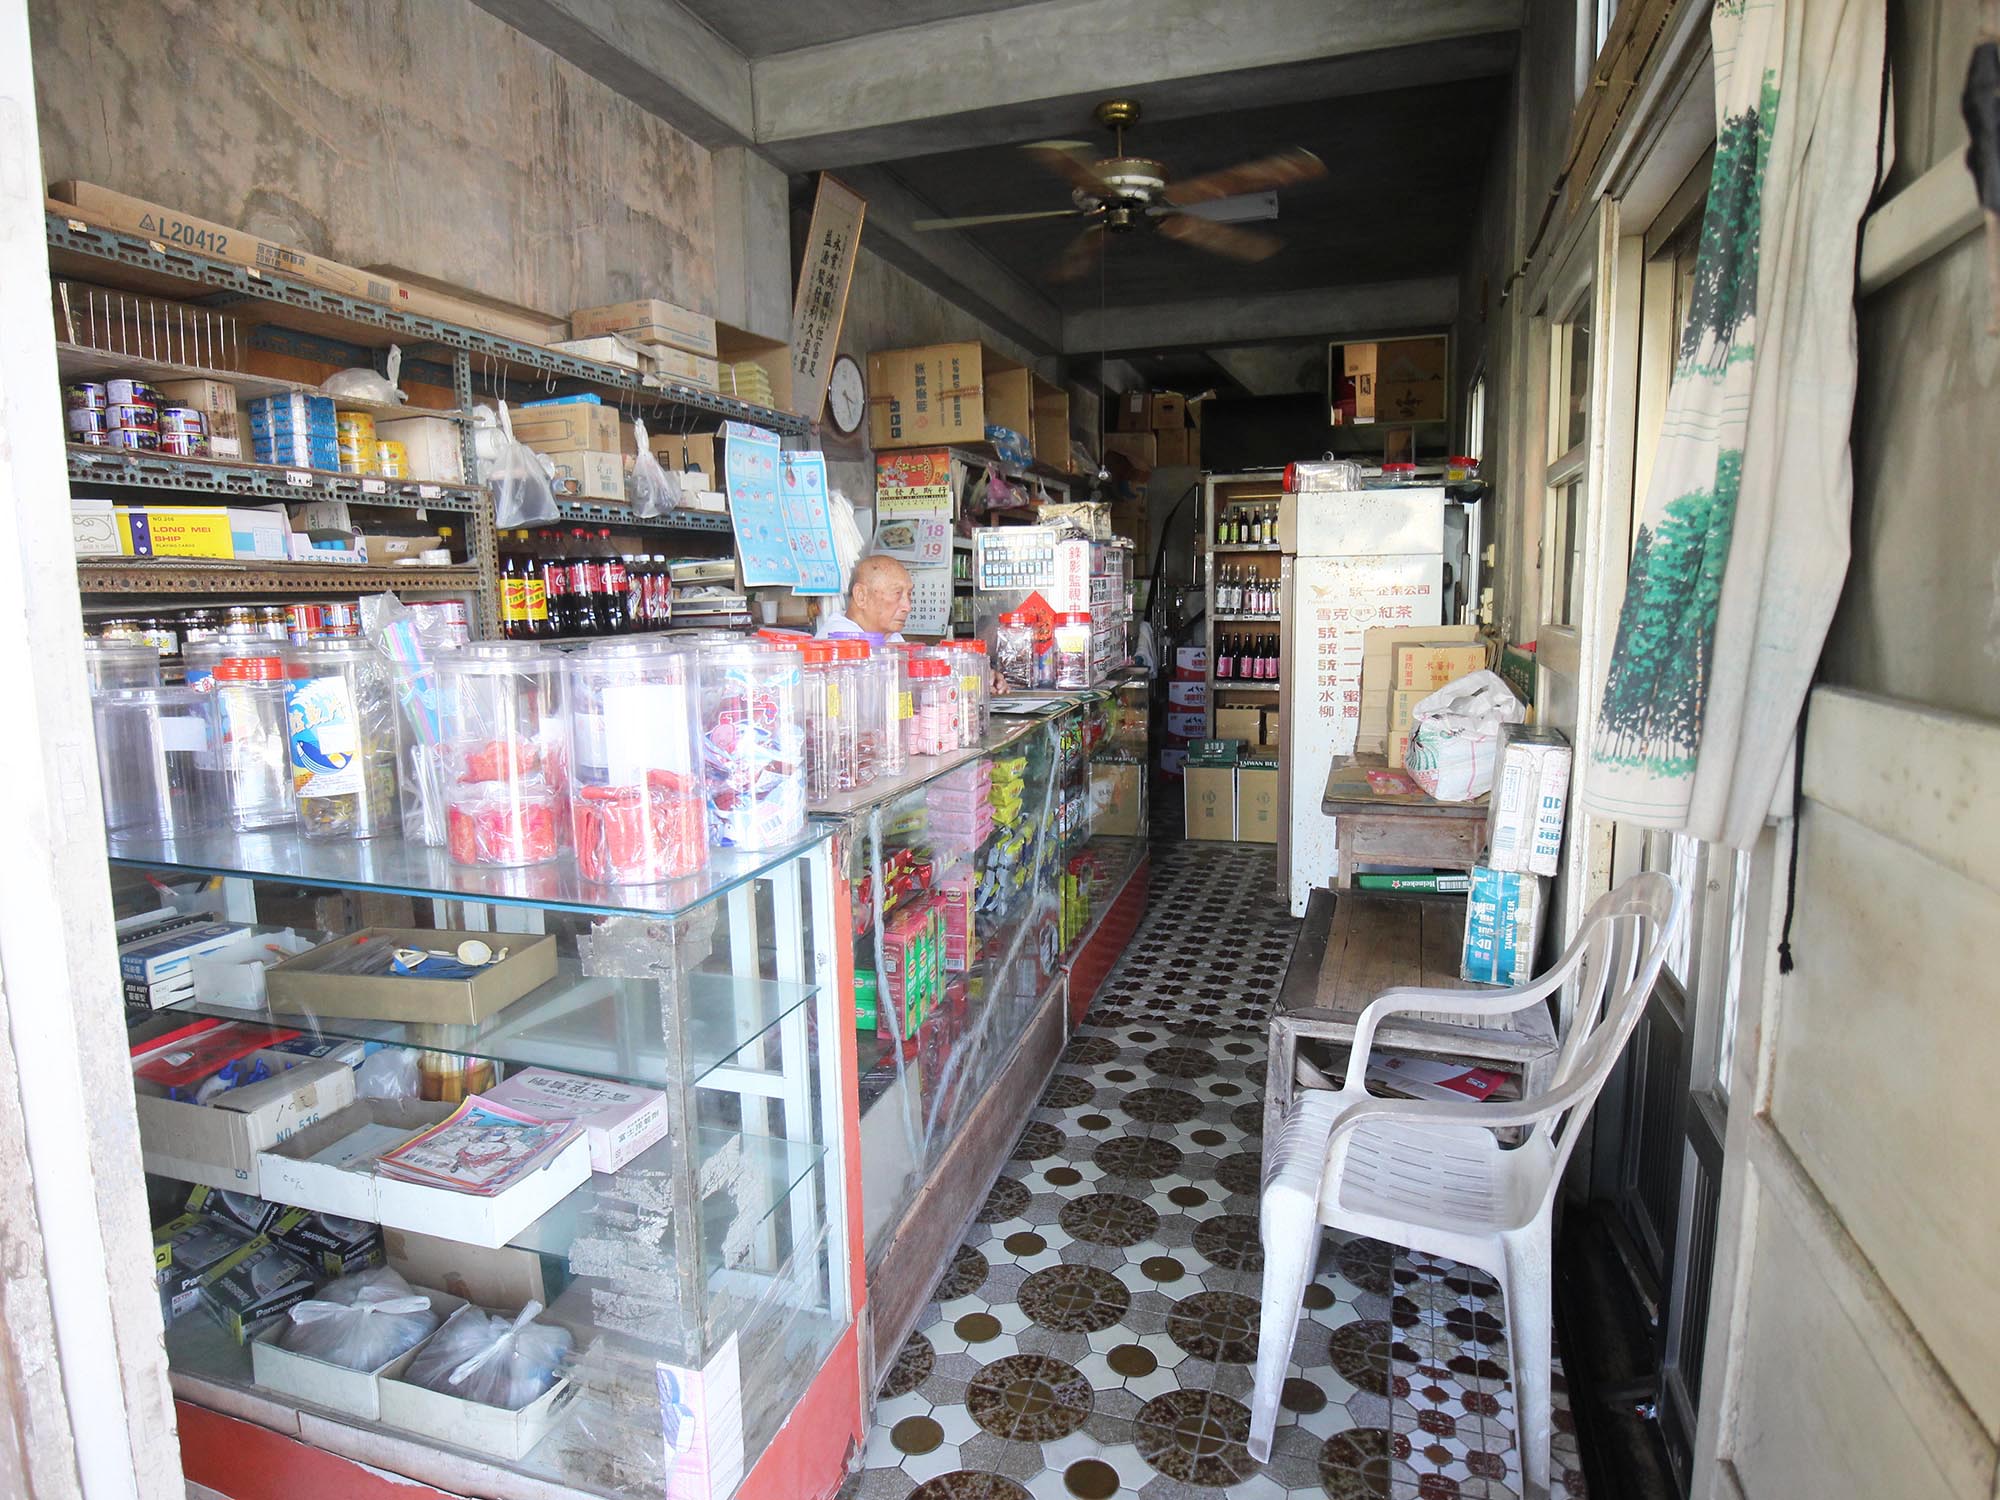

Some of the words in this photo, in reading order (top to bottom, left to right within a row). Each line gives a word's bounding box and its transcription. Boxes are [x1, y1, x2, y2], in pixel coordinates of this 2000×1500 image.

[158, 217, 228, 255] L20412
[928, 525, 944, 536] 18
[923, 544, 942, 555] 19
[1349, 584, 1430, 597] 統一企業公司
[1378, 605, 1413, 619] 紅茶
[1400, 879, 1436, 888] Heineken
[1506, 900, 1516, 921] BEER
[1505, 922, 1514, 950] TAIWAN
[256, 1295, 302, 1318] Panasonic
